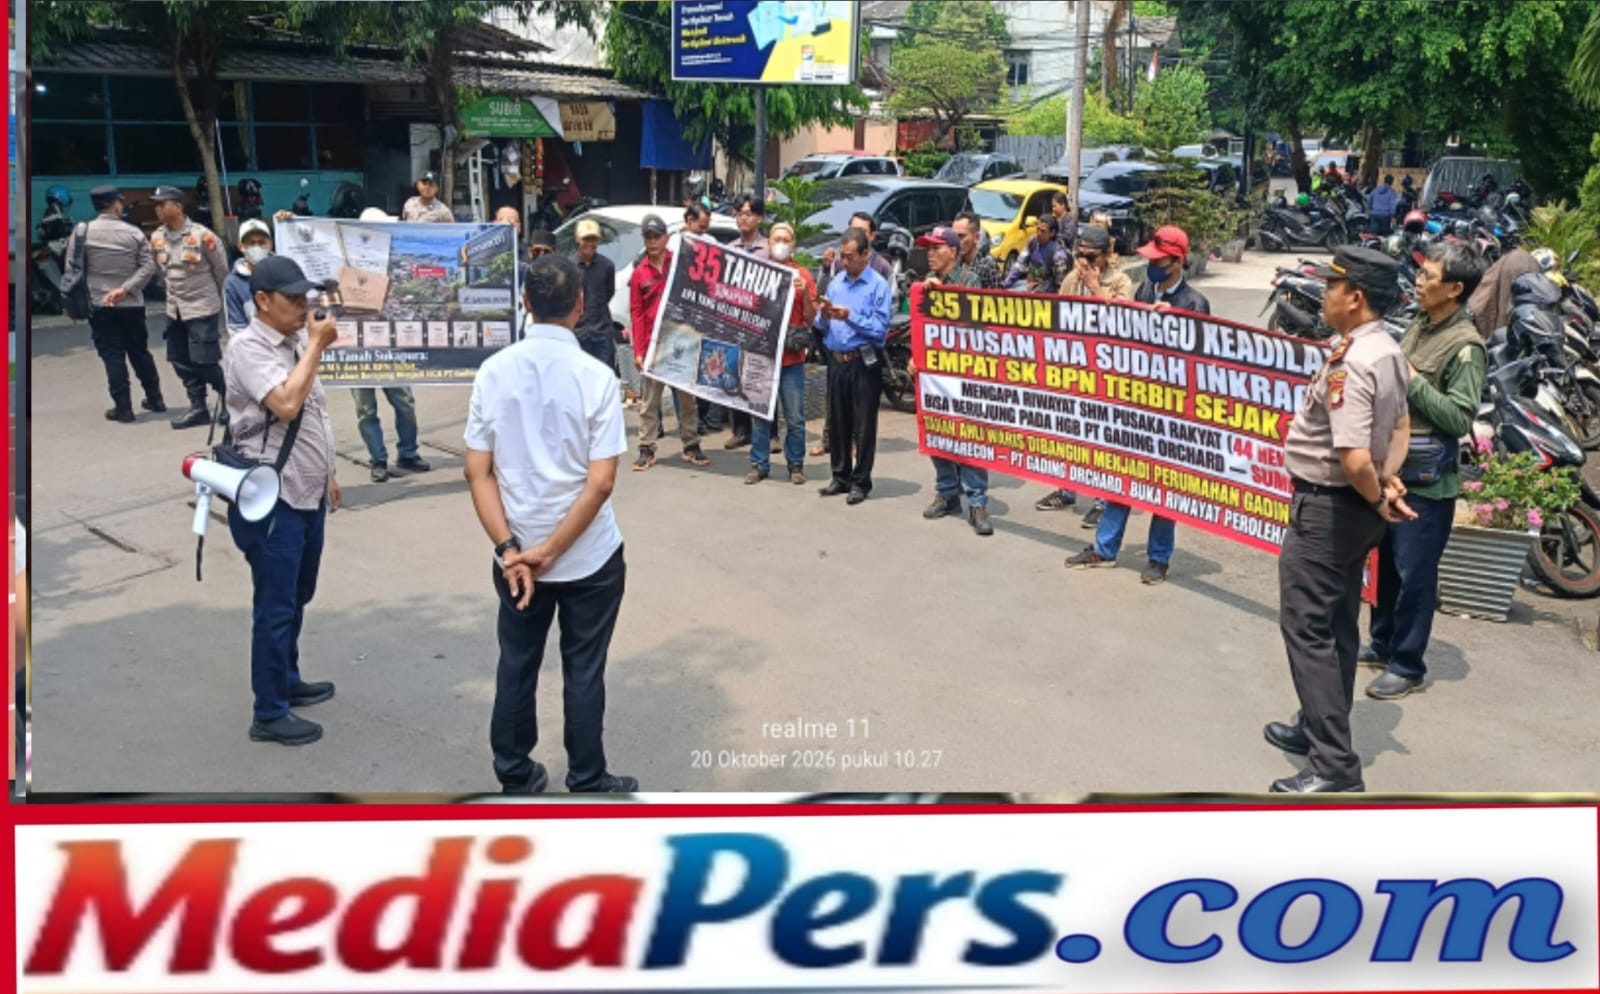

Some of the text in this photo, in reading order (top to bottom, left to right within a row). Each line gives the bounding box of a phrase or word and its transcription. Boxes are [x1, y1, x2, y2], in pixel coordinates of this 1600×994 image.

[689, 241, 783, 300] 35 TAHUN
[338, 350, 372, 361] Tanah
[924, 324, 1035, 359] PUTUSAN
[1043, 336, 1088, 366] MA
[1095, 343, 1187, 386] SUDAH
[929, 290, 961, 319] 35
[967, 295, 1051, 329] TAHUN
[1059, 301, 1196, 351] MENUNGGU
[924, 393, 949, 412] BISA
[952, 398, 1015, 424] BERUJUNG
[1019, 409, 1051, 429] PADA
[1056, 418, 1080, 437] HGB
[1085, 422, 1100, 440] PT
[1104, 426, 1154, 454] GADING
[1158, 440, 1225, 473] ORCHARD
[926, 350, 1281, 440] EMPAT SK BPN TERBIT SEJAK
[961, 382, 1020, 406] MENGAPA
[1023, 391, 1077, 416] RIWAYAT
[1079, 401, 1108, 422] SHM
[1113, 408, 1165, 436] PUSAKA
[1169, 421, 1222, 449] RAKYAT
[1227, 434, 1253, 461] (44
[925, 433, 995, 462] SUMMARECON
[1010, 450, 1024, 467] PT
[1026, 455, 1067, 479] GADING
[1129, 481, 1162, 506] BUKA
[1165, 491, 1221, 524] RIWAYAT
[960, 421, 985, 441] AHLI
[987, 427, 1025, 451] WARIS
[1028, 435, 1090, 465] DIBANGUN
[1093, 450, 1150, 481] MENJADI
[1154, 466, 1240, 508] PERUMAHAN
